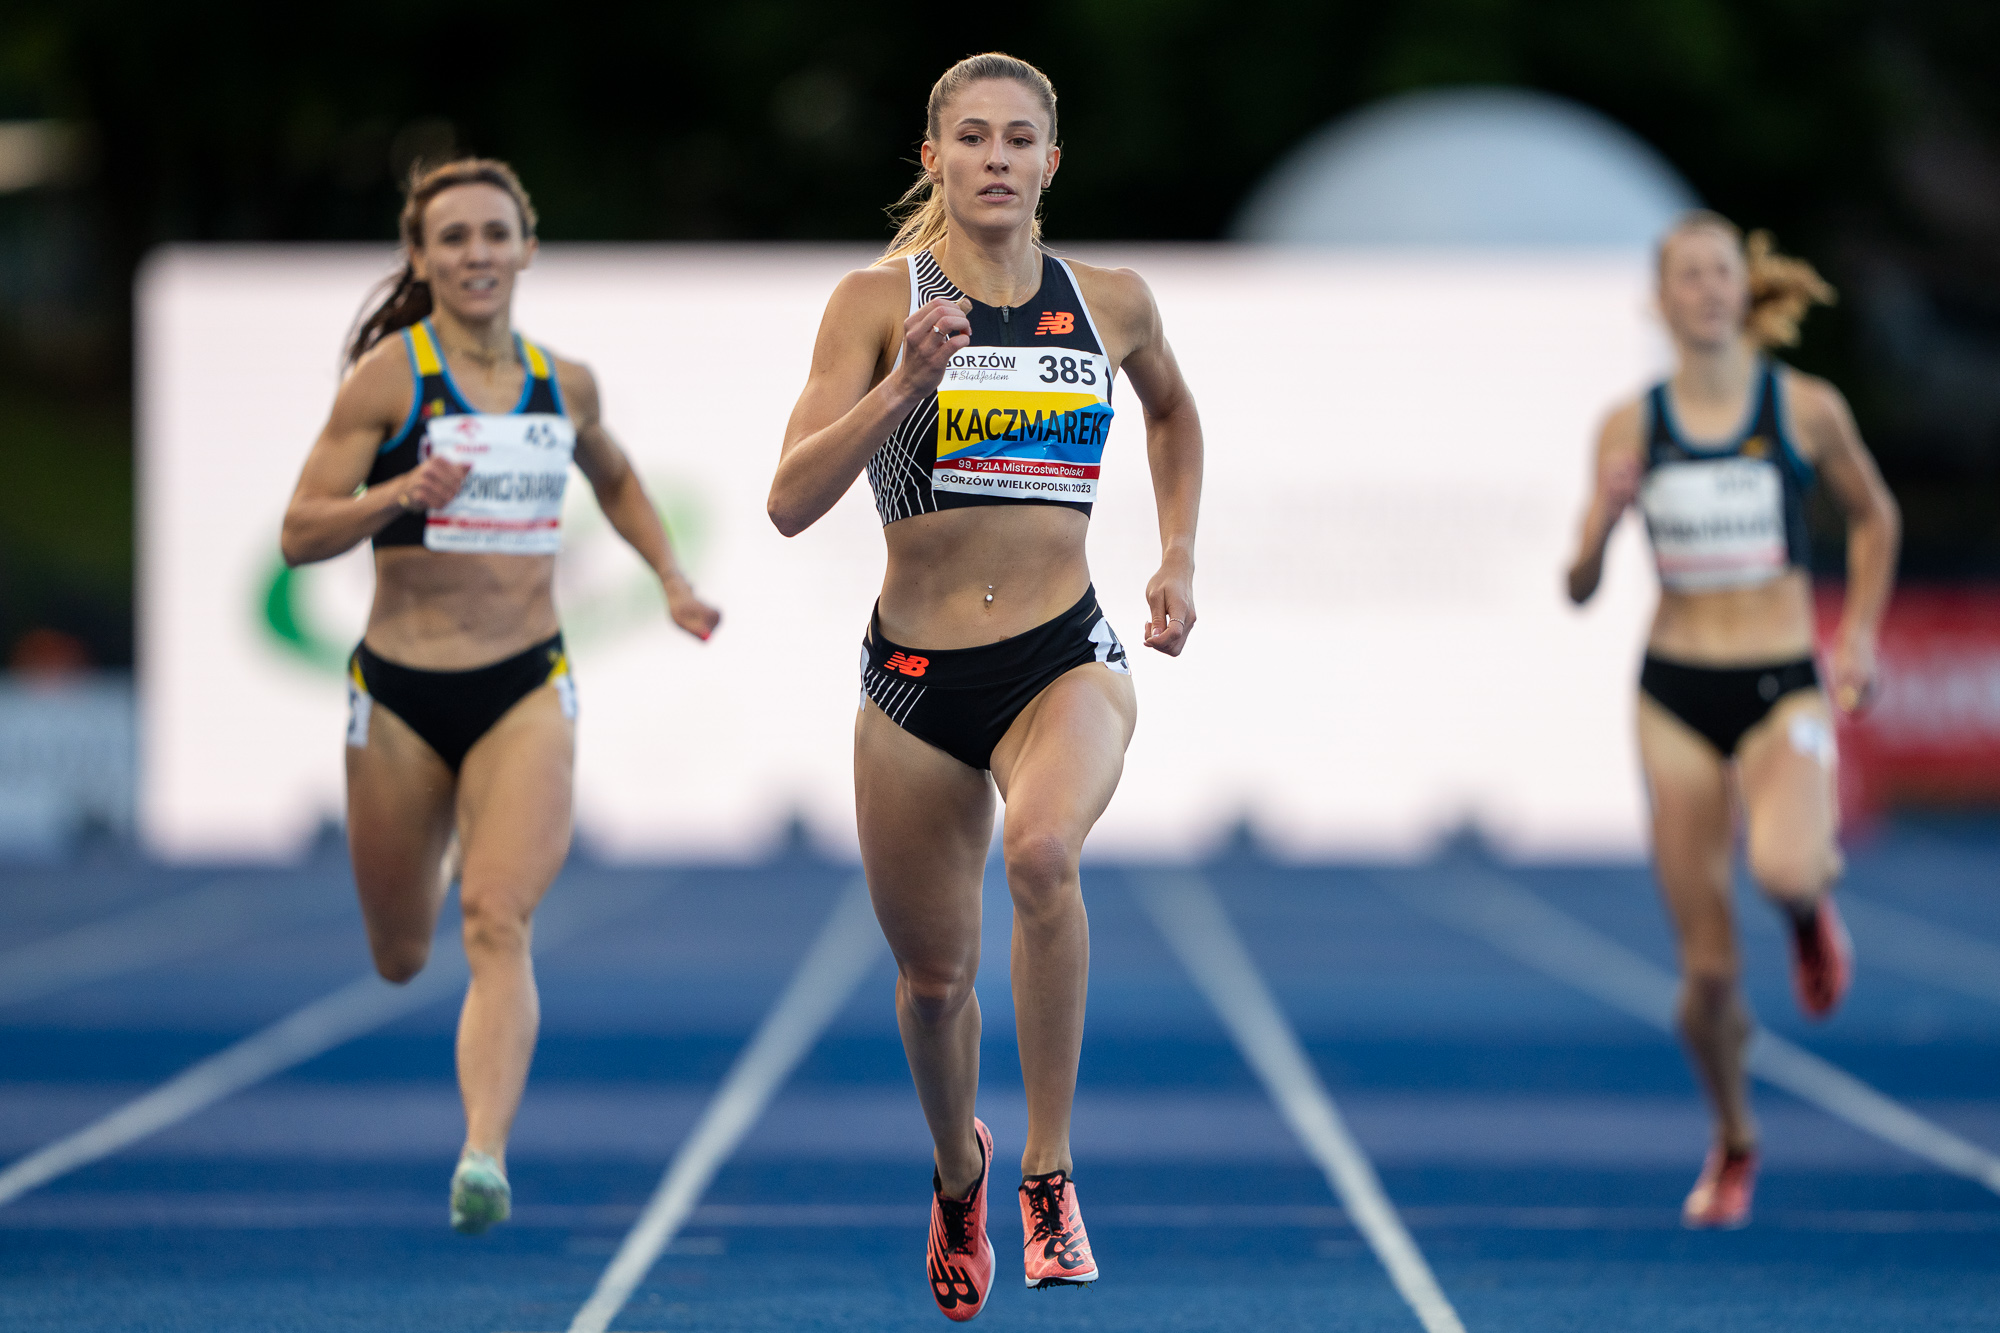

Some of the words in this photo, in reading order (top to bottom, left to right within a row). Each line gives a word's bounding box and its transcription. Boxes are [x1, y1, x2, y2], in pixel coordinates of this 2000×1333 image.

[1034, 311, 1075, 335] NB
[1038, 355, 1097, 386] 385
[946, 408, 1108, 445] KACZMAREK
[958, 459, 974, 470] 99.
[976, 461, 1000, 472] PZLA
[1003, 462, 1059, 476] Mistrzostwa
[1059, 465, 1085, 478] Polski
[941, 474, 994, 487] GORZÓW
[997, 479, 1071, 493] WIELKOPOLSKI
[1071, 484, 1091, 494] 2023
[883, 651, 930, 677] NB
